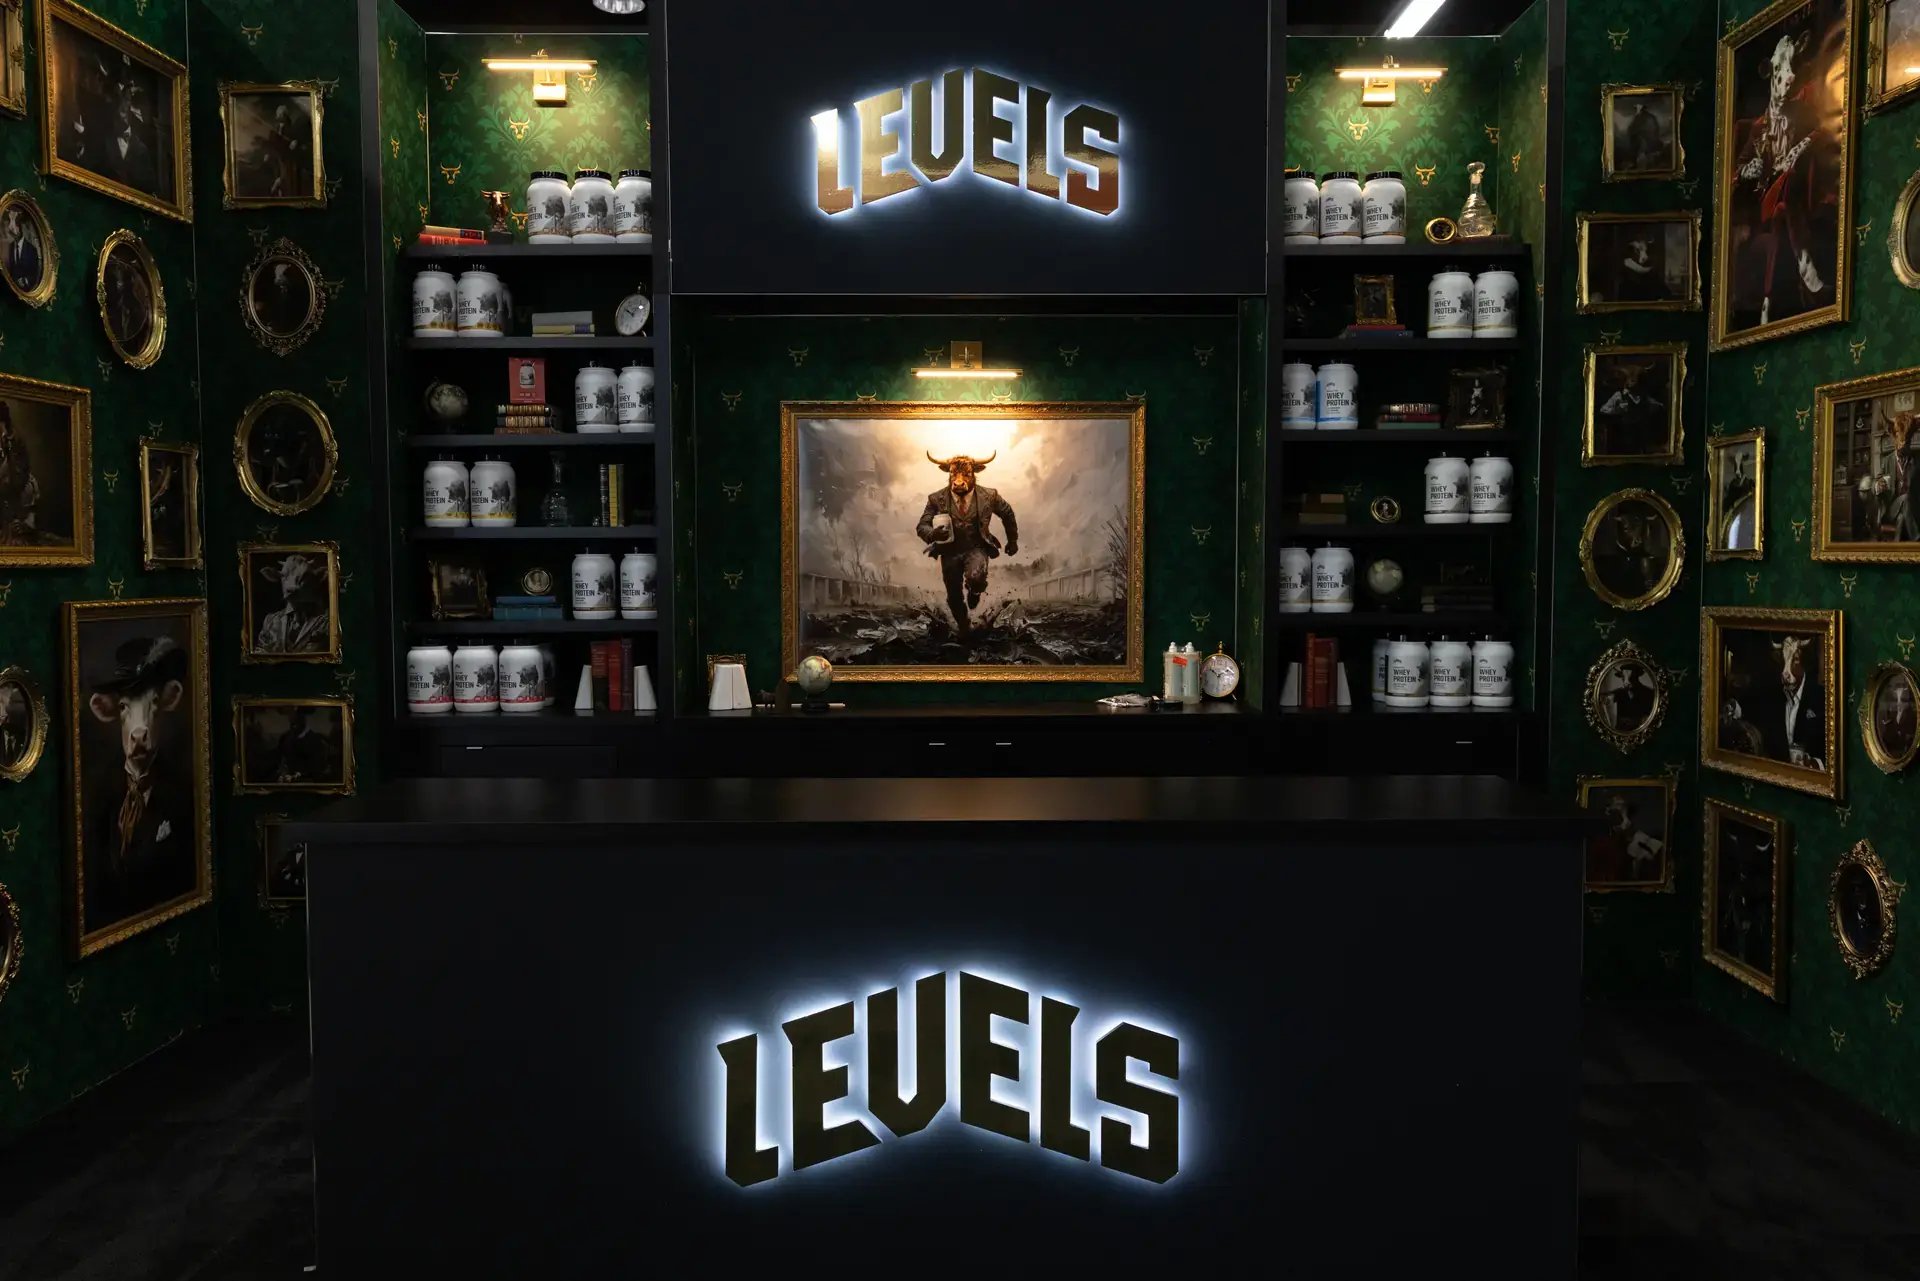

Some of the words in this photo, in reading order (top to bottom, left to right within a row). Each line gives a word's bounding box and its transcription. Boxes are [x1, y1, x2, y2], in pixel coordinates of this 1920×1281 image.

[810, 66, 1120, 216] LEVELS
[1326, 206, 1342, 214] WHEY
[1366, 206, 1382, 215] WHEY
[1325, 214, 1348, 222] PROTEIN
[1366, 214, 1388, 222] PROTEIN
[1434, 306, 1457, 314] PROTEIN
[716, 970, 1180, 1187] LEVELS
